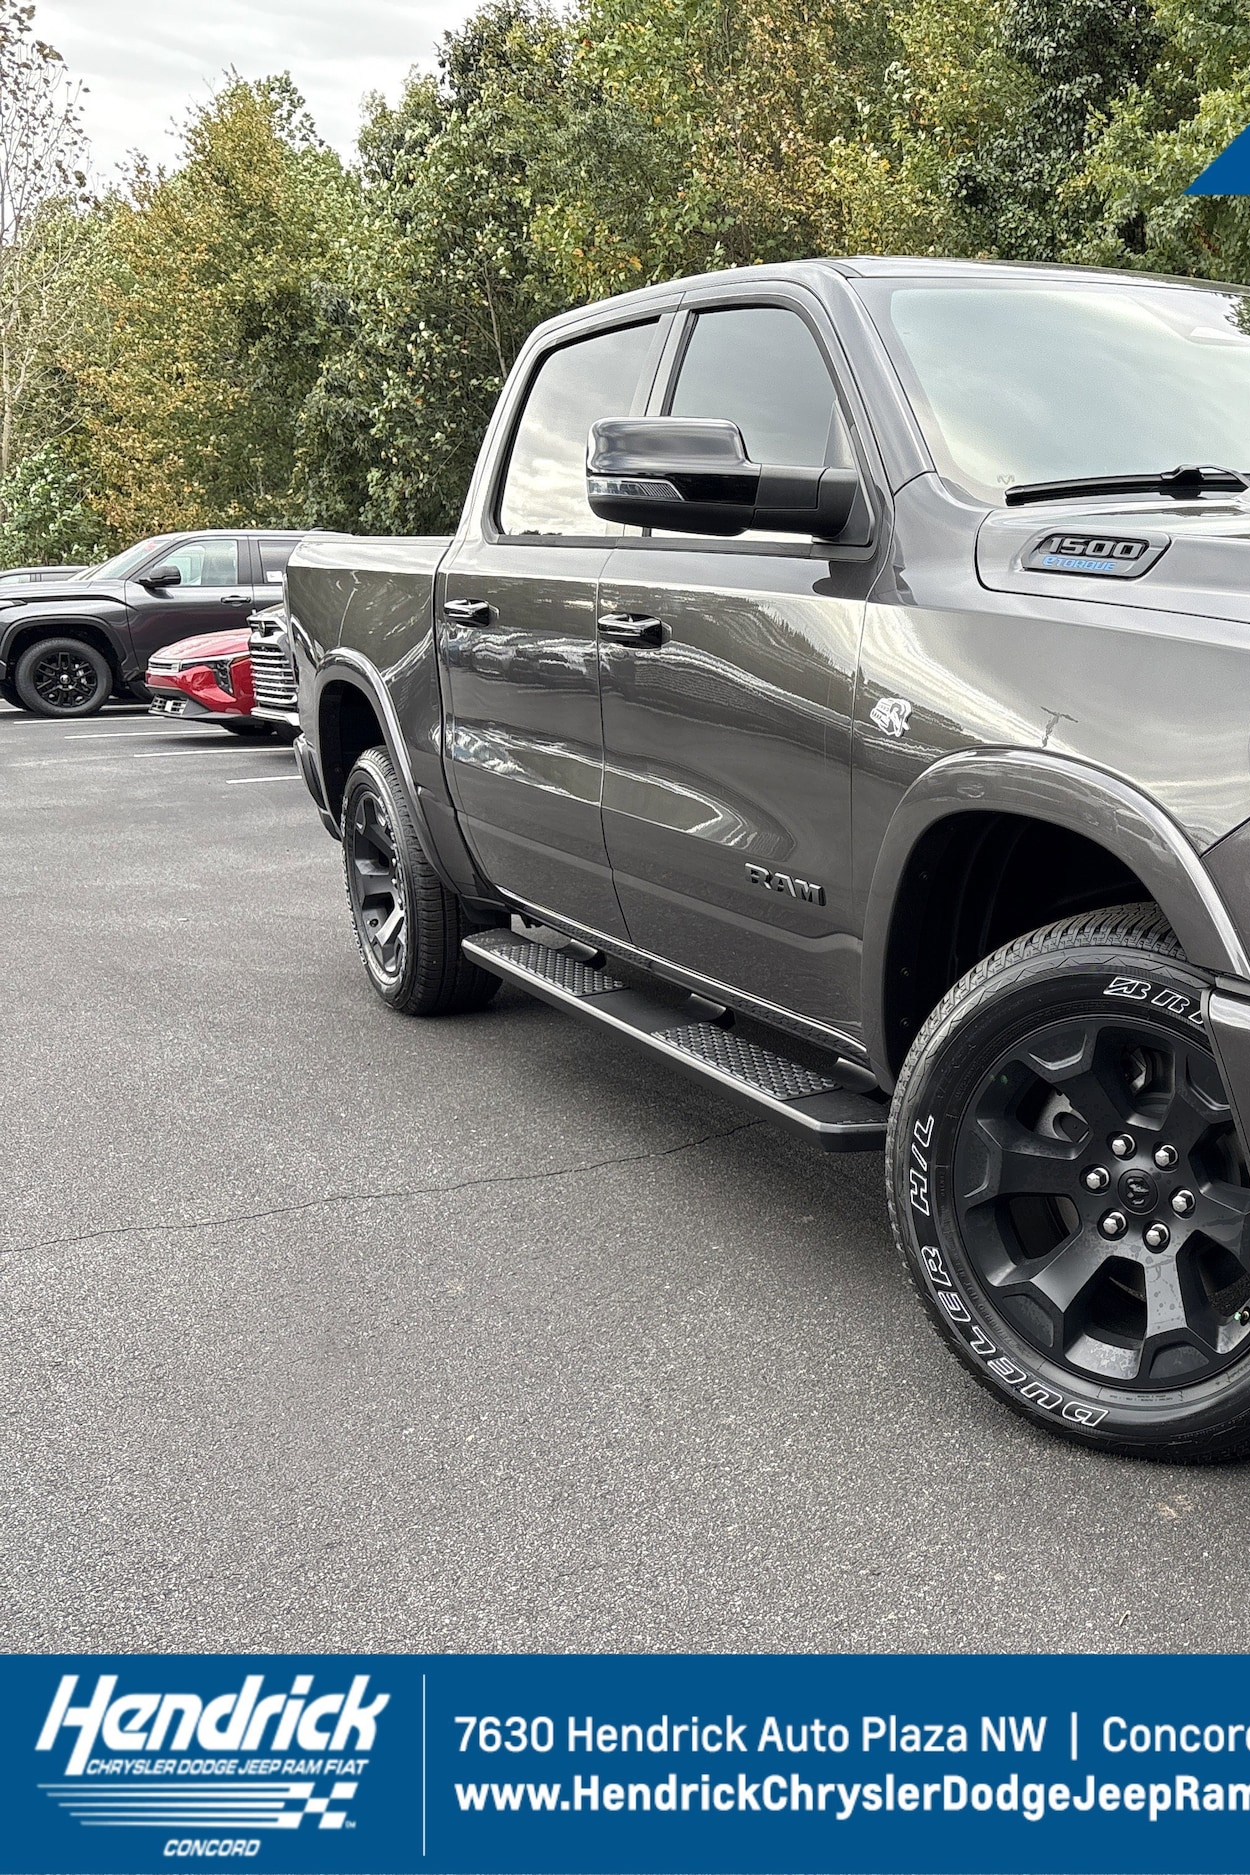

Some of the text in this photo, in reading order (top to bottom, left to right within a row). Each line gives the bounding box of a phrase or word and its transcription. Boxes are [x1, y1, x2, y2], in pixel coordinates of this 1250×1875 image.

[1049, 537, 1144, 559] 1500
[744, 862, 827, 906] RAM
[909, 1114, 935, 1217] H/L
[920, 1245, 1110, 1428] DUELER
